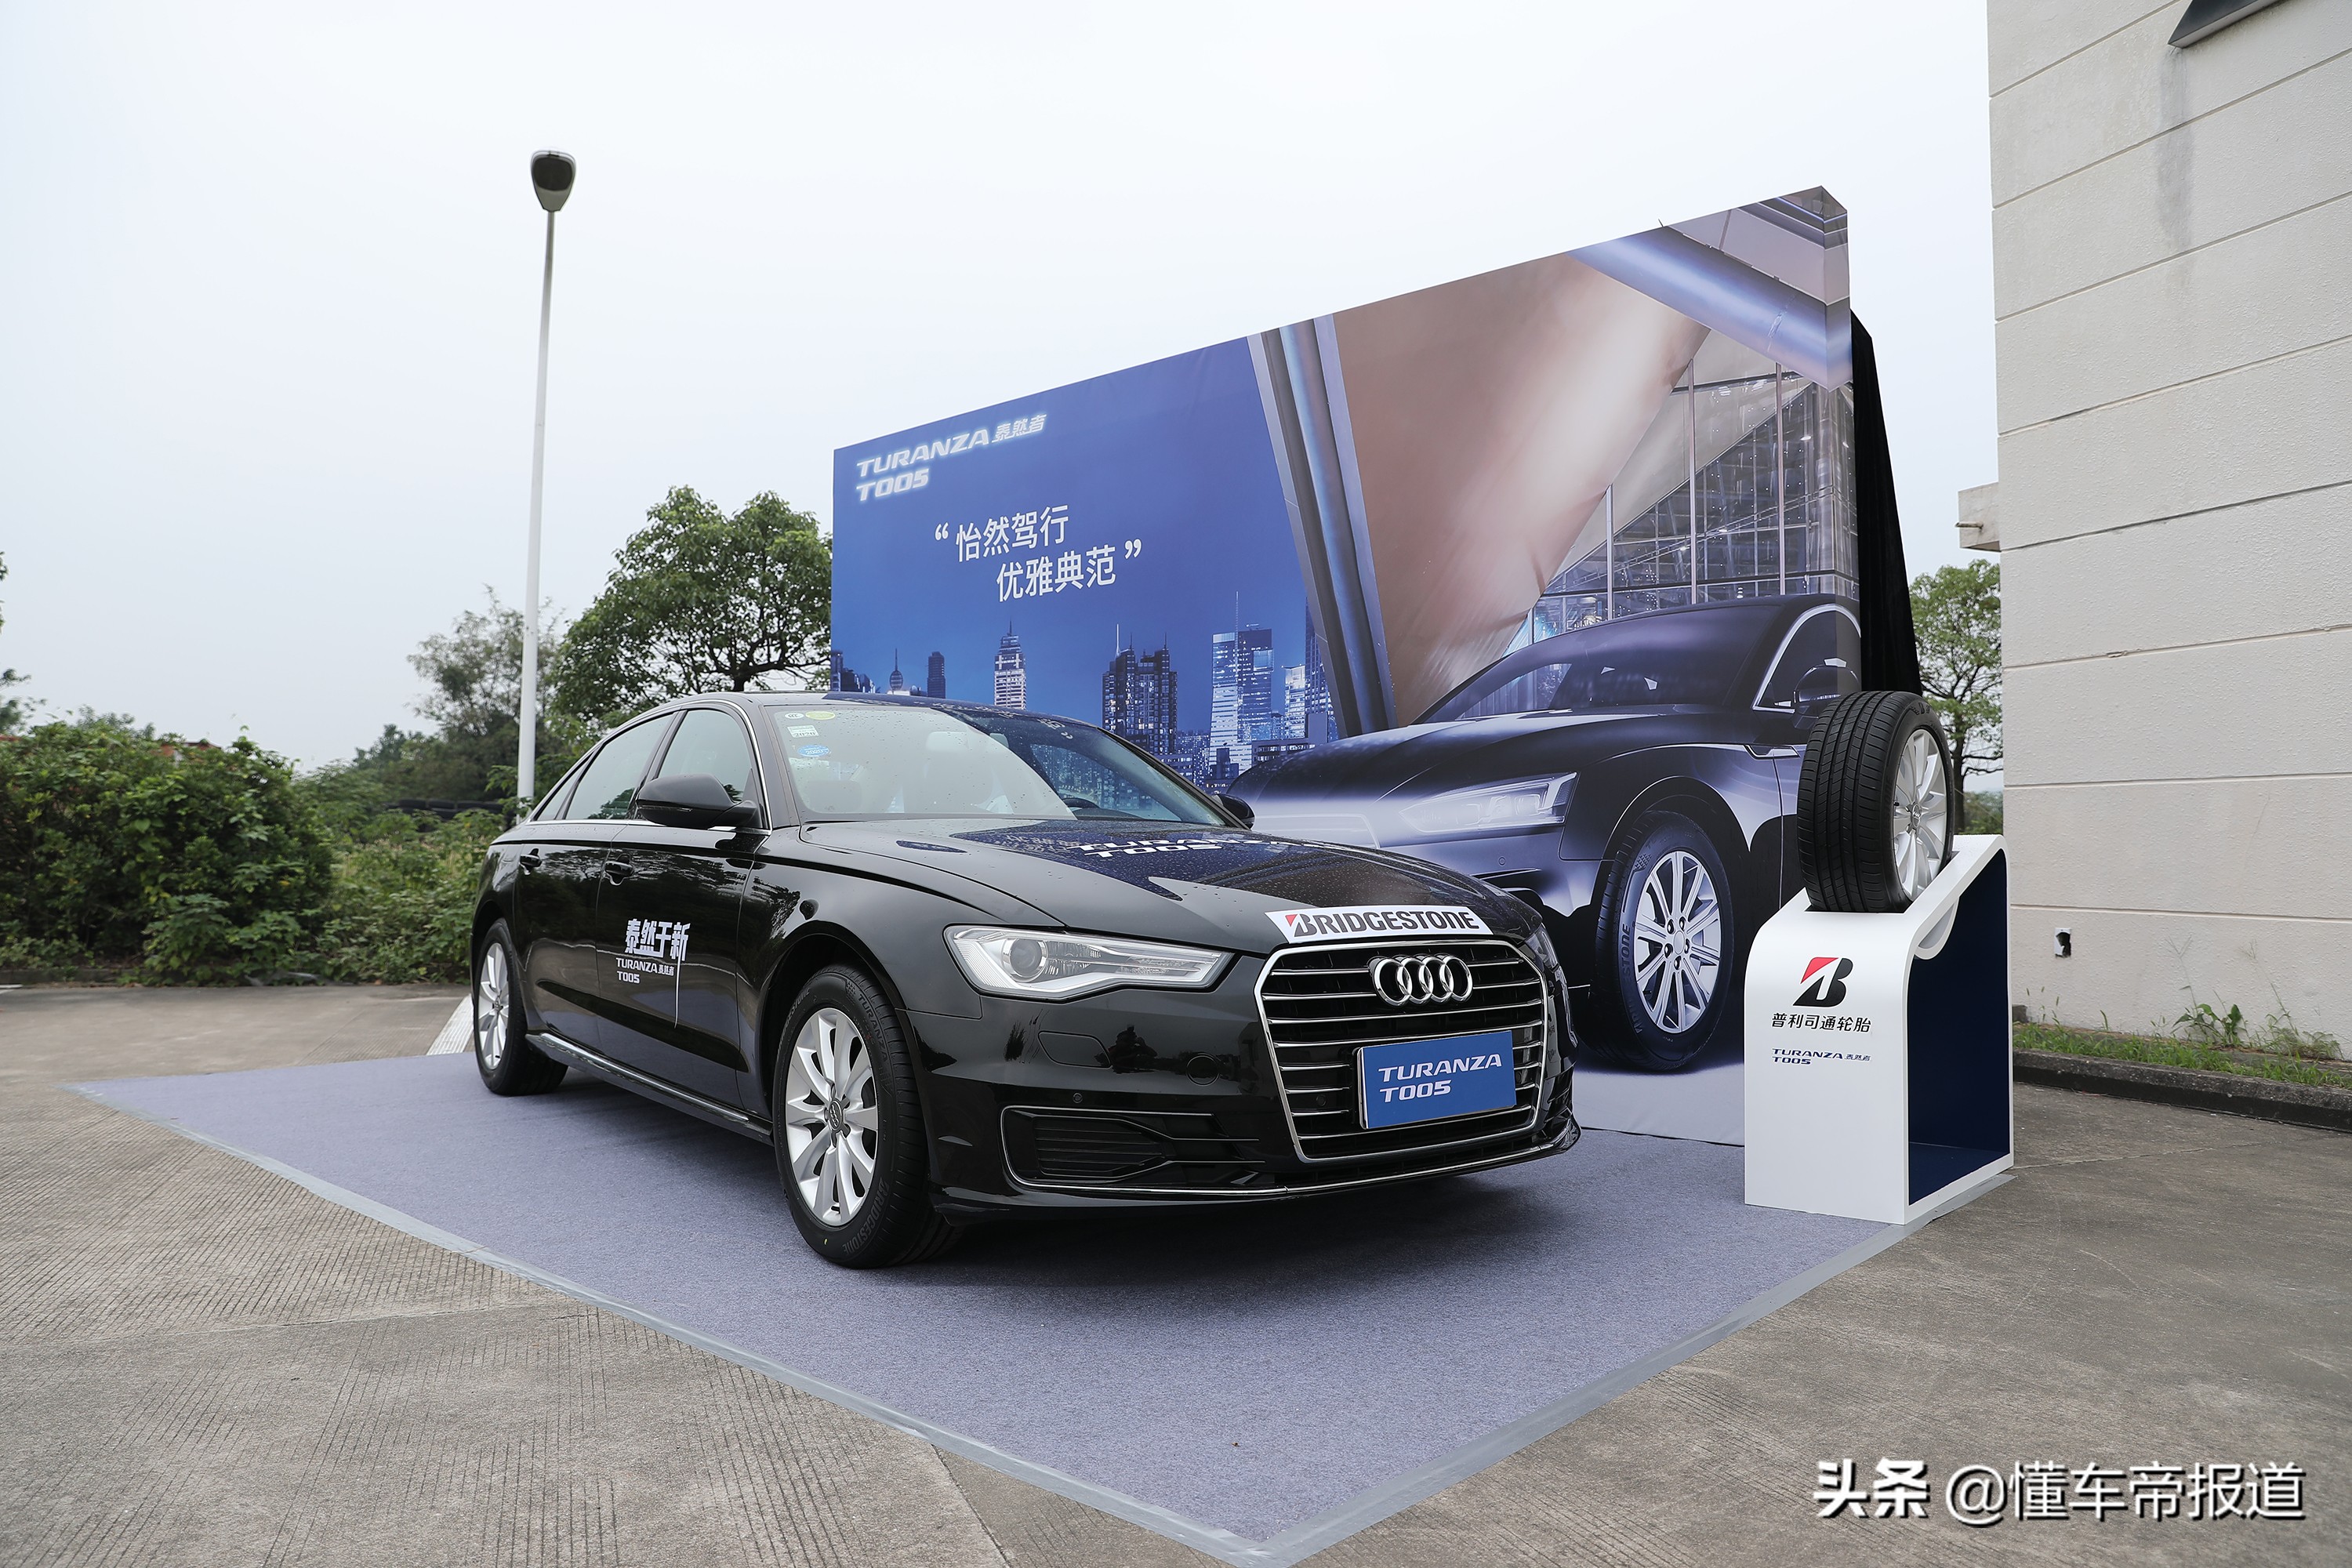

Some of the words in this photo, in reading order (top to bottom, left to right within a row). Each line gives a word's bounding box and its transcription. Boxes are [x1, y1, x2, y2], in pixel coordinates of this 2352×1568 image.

[855, 428, 989, 477] TURANZA
[991, 414, 1047, 443] 泰然者
[855, 468, 930, 502] T005
[1083, 843, 1223, 858] T005
[1285, 910, 1480, 938] BRIDGESTONE
[615, 957, 658, 975] TURANZA
[616, 971, 641, 984] T005
[858, 993, 888, 1062] TURANZA
[1771, 1012, 1872, 1033] 普利司通轮胎
[1772, 1048, 1843, 1060] TURANZA
[1772, 1056, 1812, 1065] T005
[1377, 1053, 1503, 1083] TURANZA
[1379, 1079, 1453, 1104] T005
[842, 1176, 891, 1255] BRIDGESTONE
